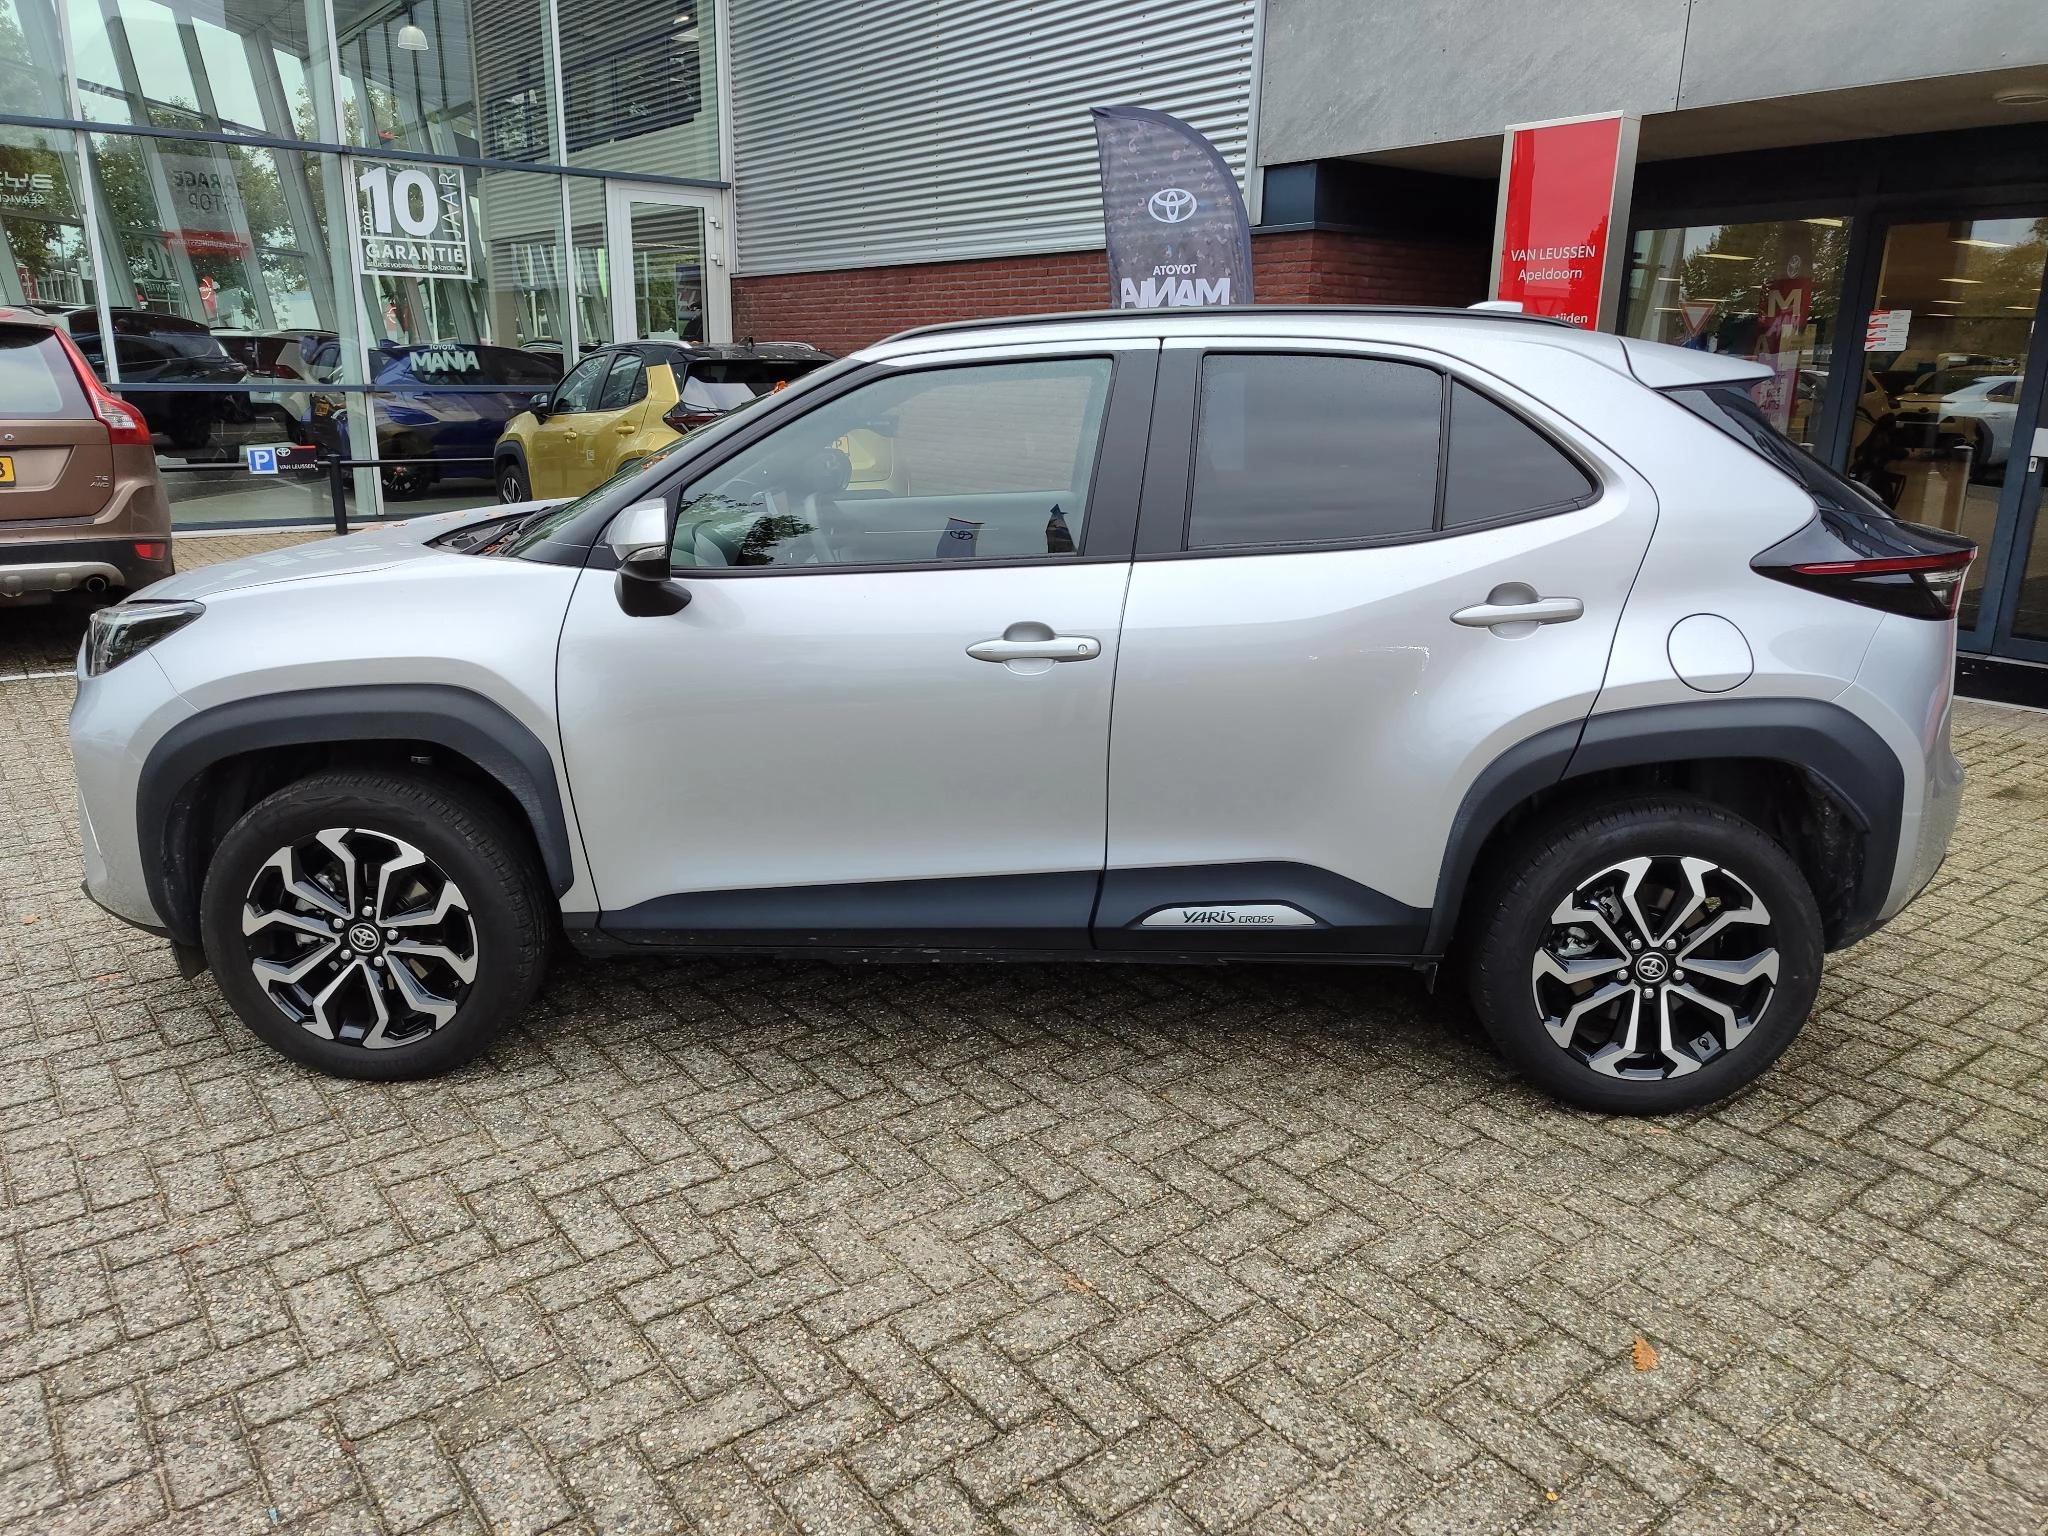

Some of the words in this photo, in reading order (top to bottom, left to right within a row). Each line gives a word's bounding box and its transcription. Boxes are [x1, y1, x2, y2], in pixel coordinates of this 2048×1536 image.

[359, 166, 439, 236] 10
[438, 173, 462, 239] JAAR
[365, 243, 465, 263] GARANTIE
[1511, 249, 1537, 262] VAN
[1540, 245, 1596, 260] LEUSSEN
[1518, 268, 1583, 284] Apeldoorn
[409, 350, 480, 373] MANIA
[254, 451, 270, 470] P
[1238, 915, 1275, 924] CROSS
